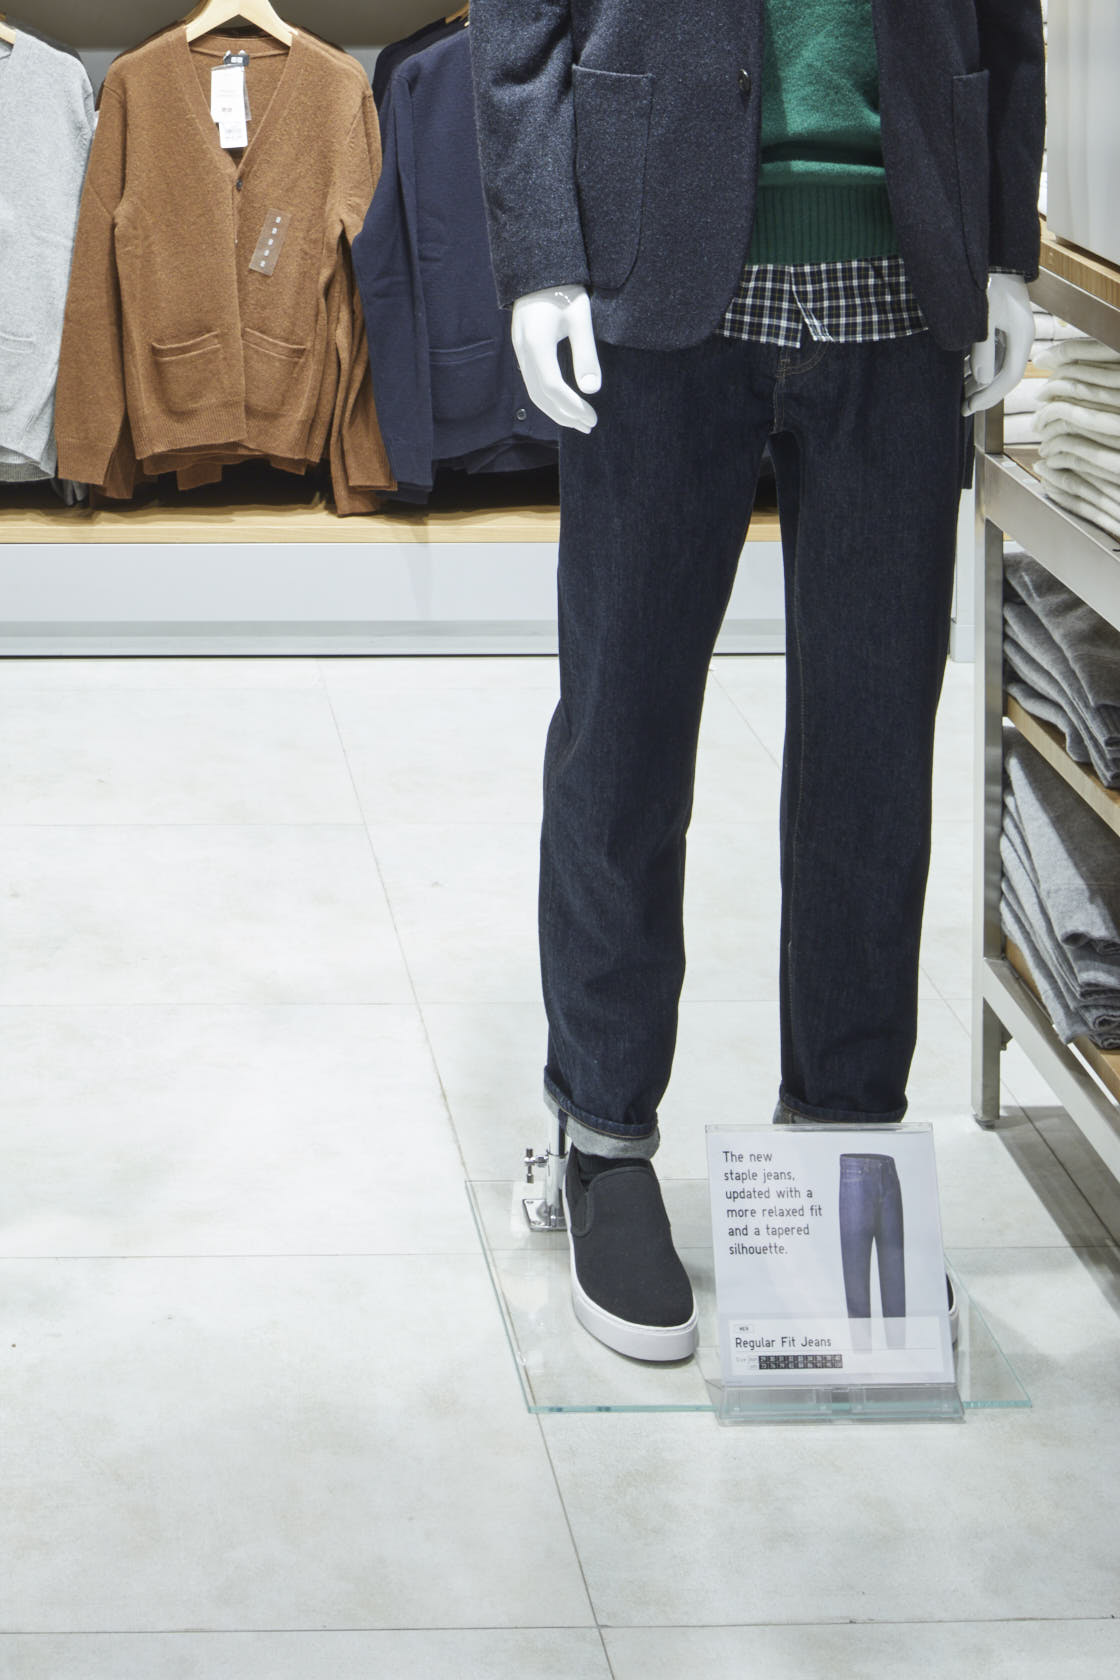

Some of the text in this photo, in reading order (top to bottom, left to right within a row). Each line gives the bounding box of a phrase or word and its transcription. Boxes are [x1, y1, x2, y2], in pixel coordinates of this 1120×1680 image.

[722, 1150, 773, 1163] The new
[724, 1169, 795, 1184] staple jeans,
[725, 1186, 813, 1202] updated with a
[726, 1204, 823, 1219] more relaxed fit
[728, 1223, 810, 1239] and a tapered
[729, 1242, 788, 1256] silhouette.
[735, 1336, 832, 1351] Regular Fit Jeans
